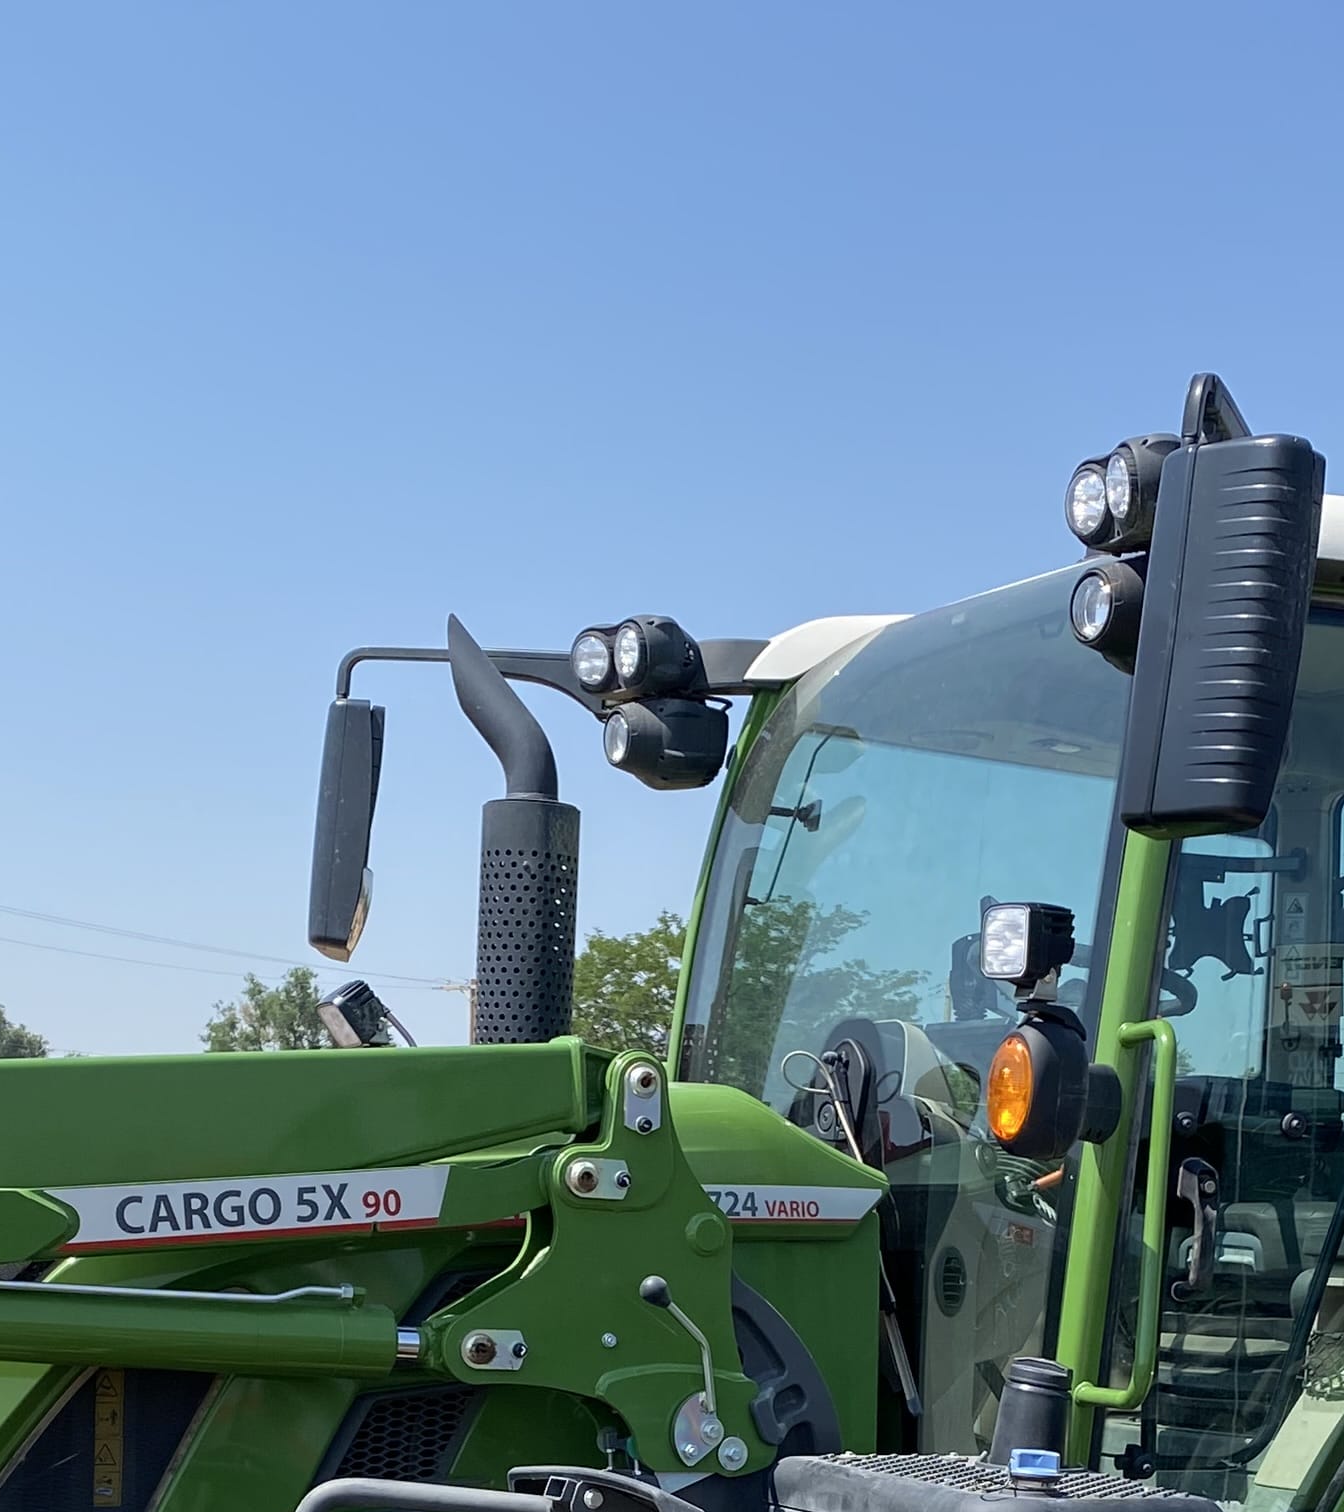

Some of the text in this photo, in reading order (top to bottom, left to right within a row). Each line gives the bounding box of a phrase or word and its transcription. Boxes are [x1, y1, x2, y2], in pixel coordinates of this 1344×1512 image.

[114, 1182, 402, 1235] CARGO 5X 90
[765, 1200, 820, 1218] VARIO
